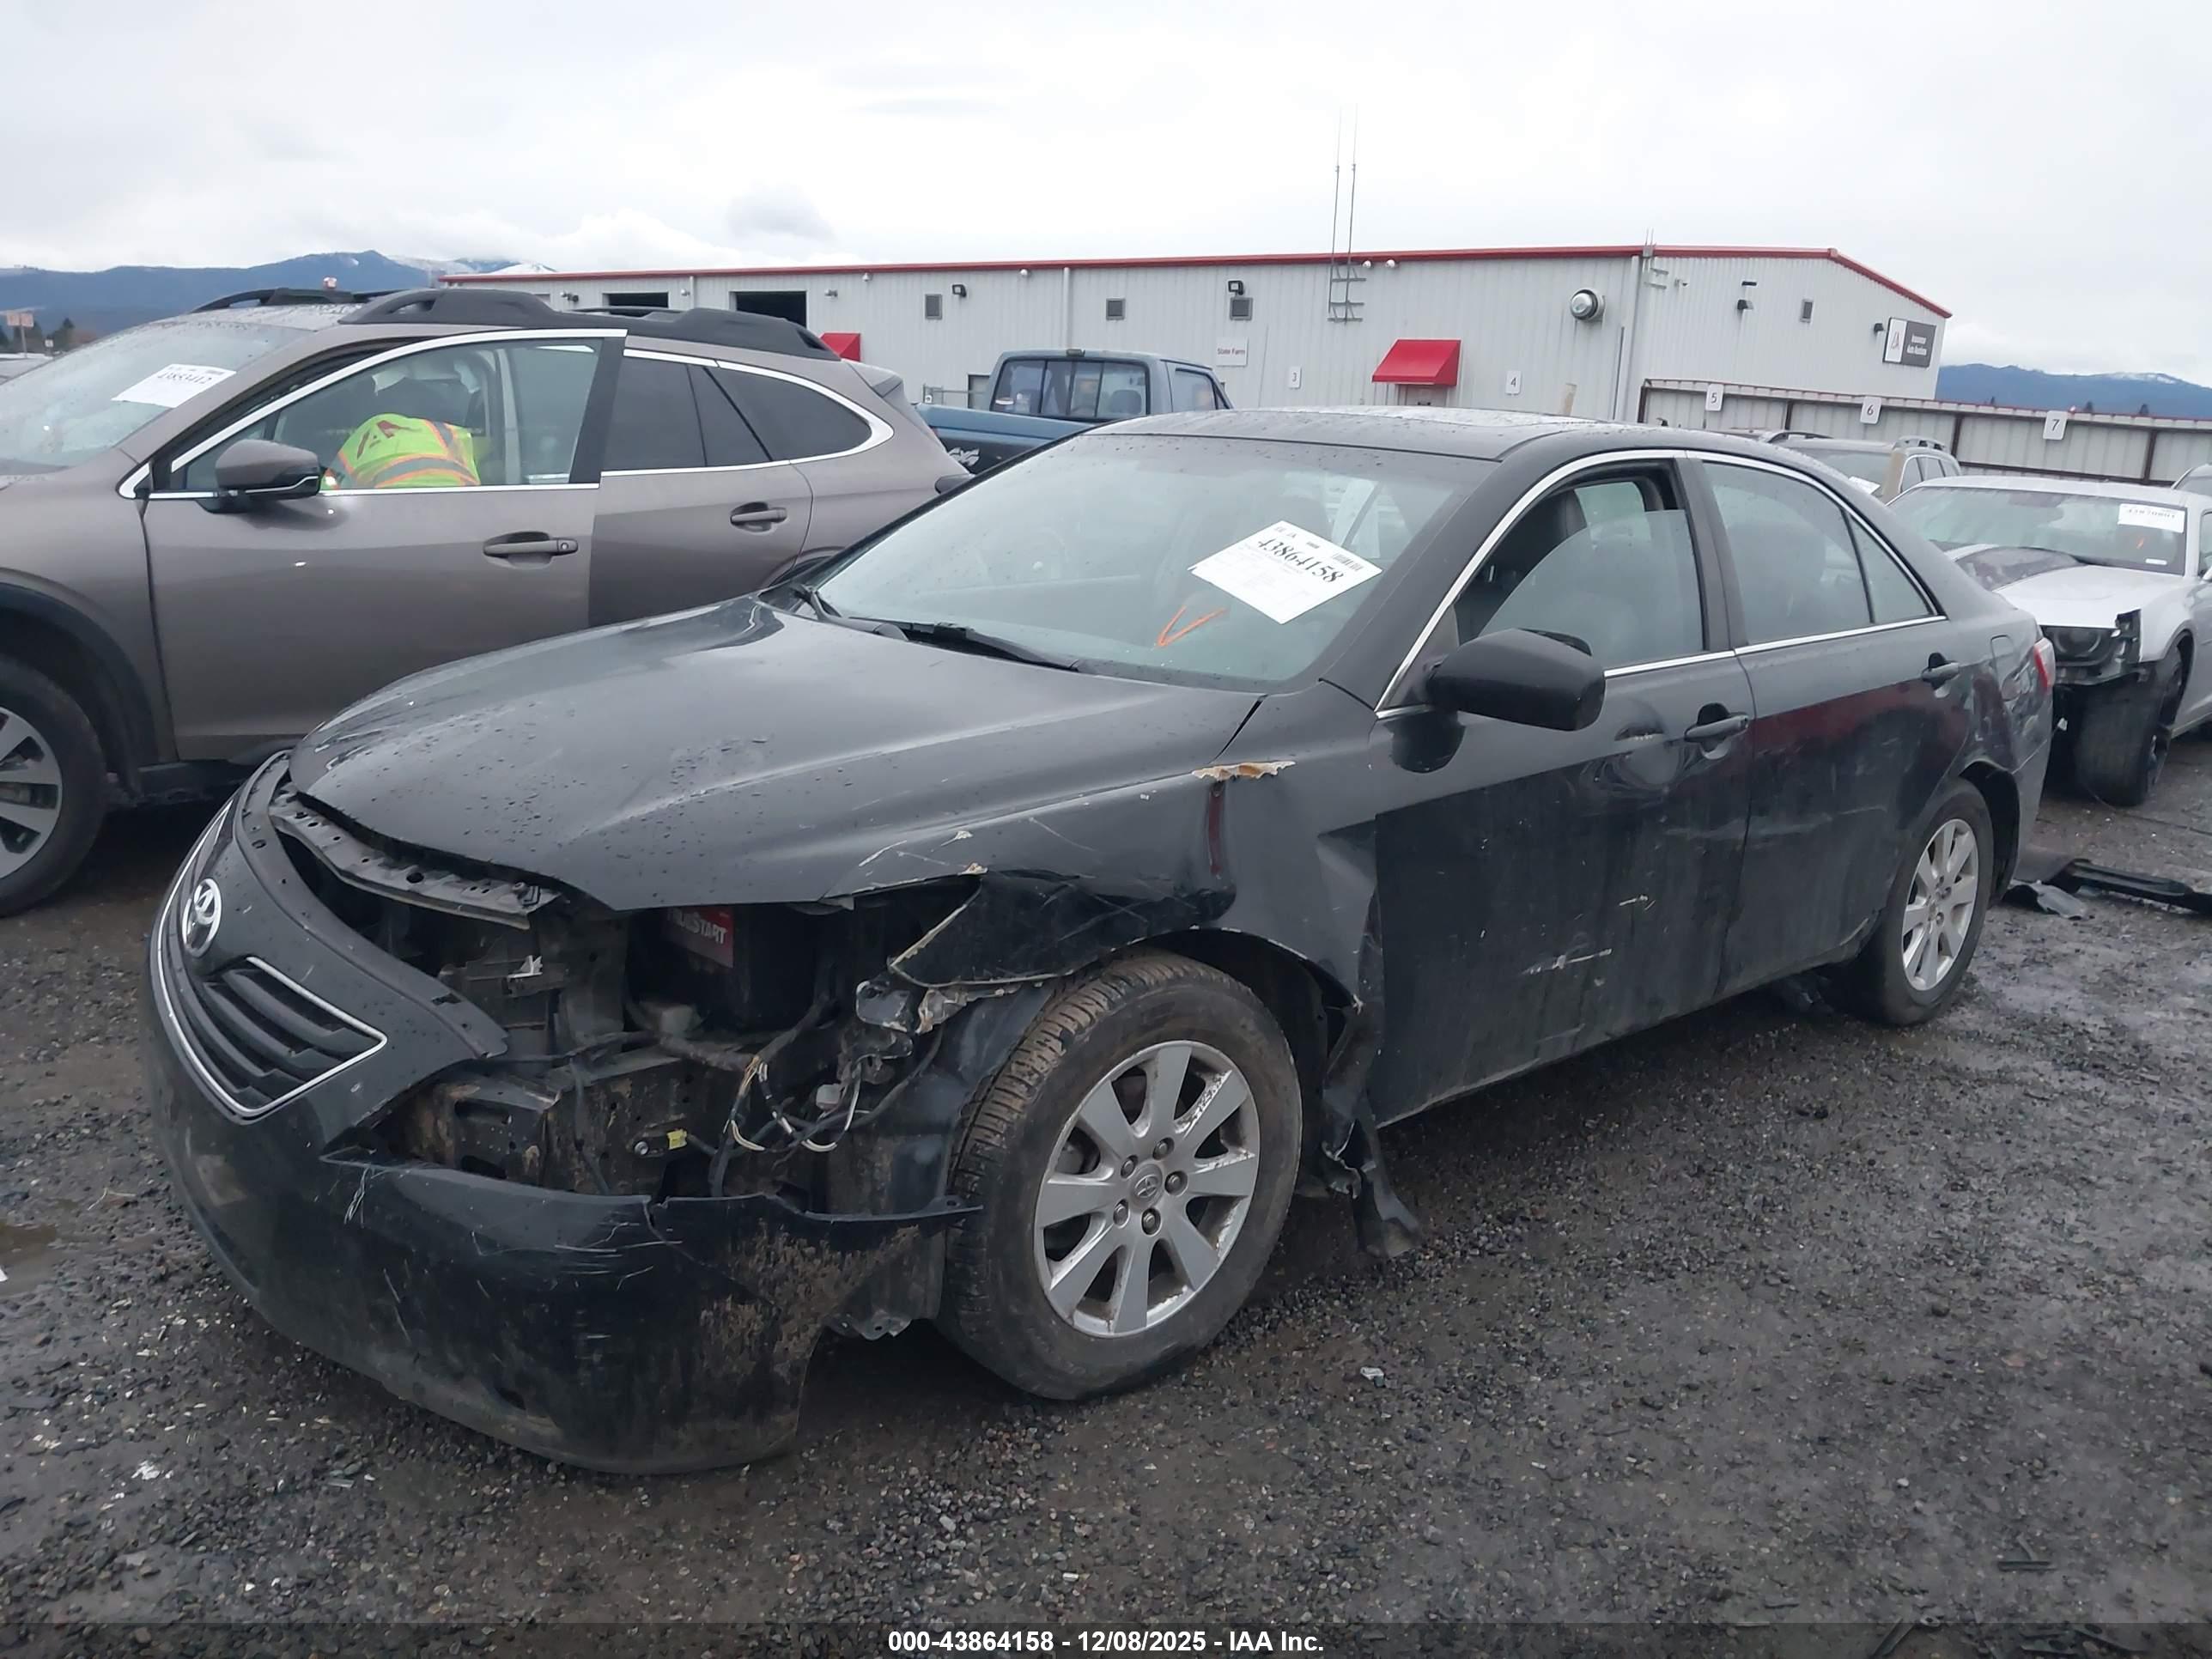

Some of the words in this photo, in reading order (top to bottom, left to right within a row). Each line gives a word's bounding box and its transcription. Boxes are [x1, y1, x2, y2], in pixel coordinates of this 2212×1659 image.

[1711, 392, 1718, 404] 5
[1867, 404, 1875, 416] 6
[2052, 418, 2061, 432] 7
[1257, 538, 1345, 583] 43864158
